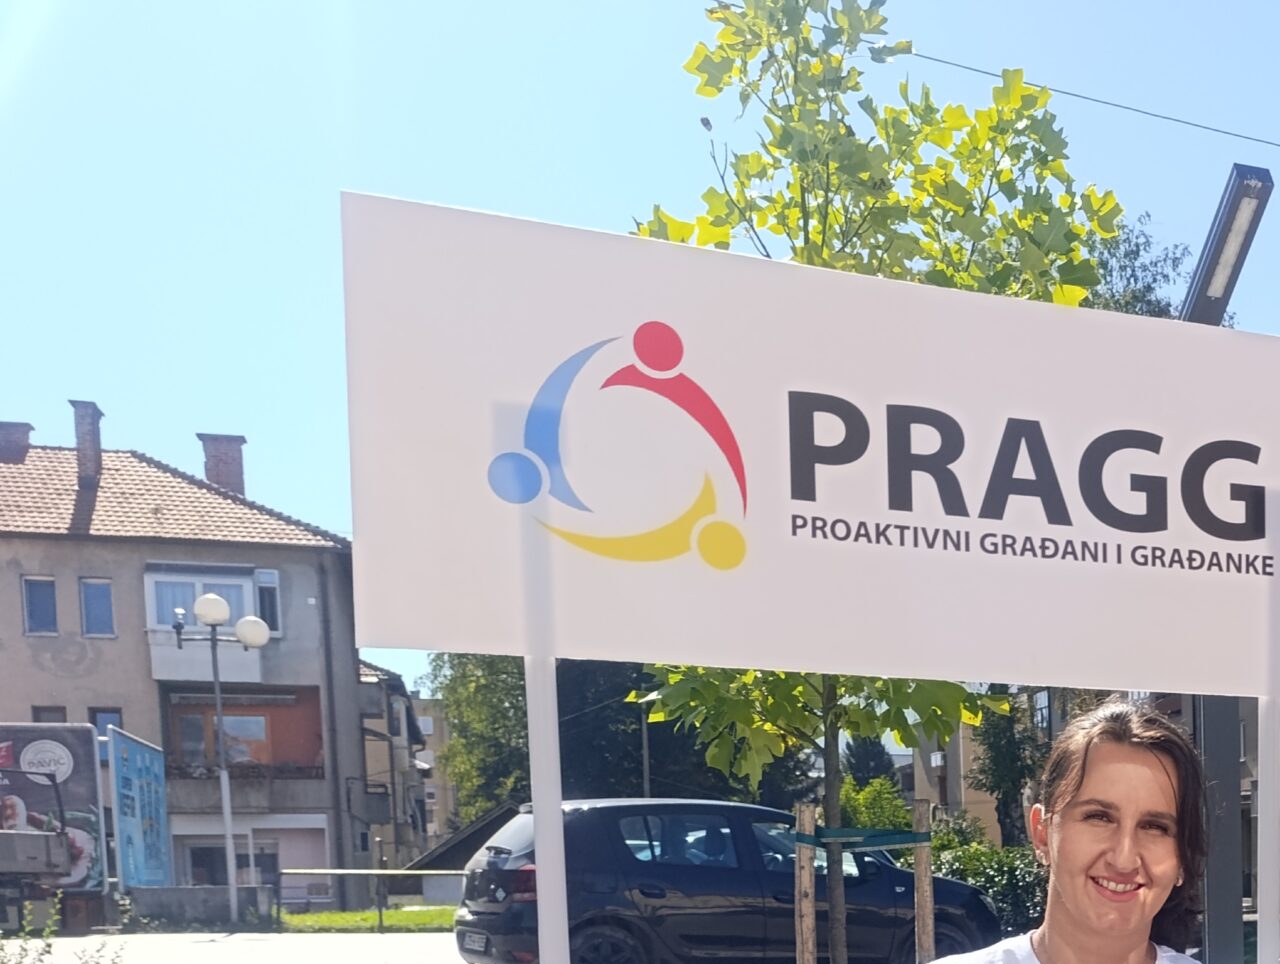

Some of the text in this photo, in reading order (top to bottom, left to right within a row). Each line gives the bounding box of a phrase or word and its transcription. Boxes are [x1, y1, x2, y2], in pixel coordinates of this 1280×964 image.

[788, 390, 1266, 542] PRAGG
[790, 514, 1275, 577] PROAKTIVNI GRAĐANI I GRAĐANKE
